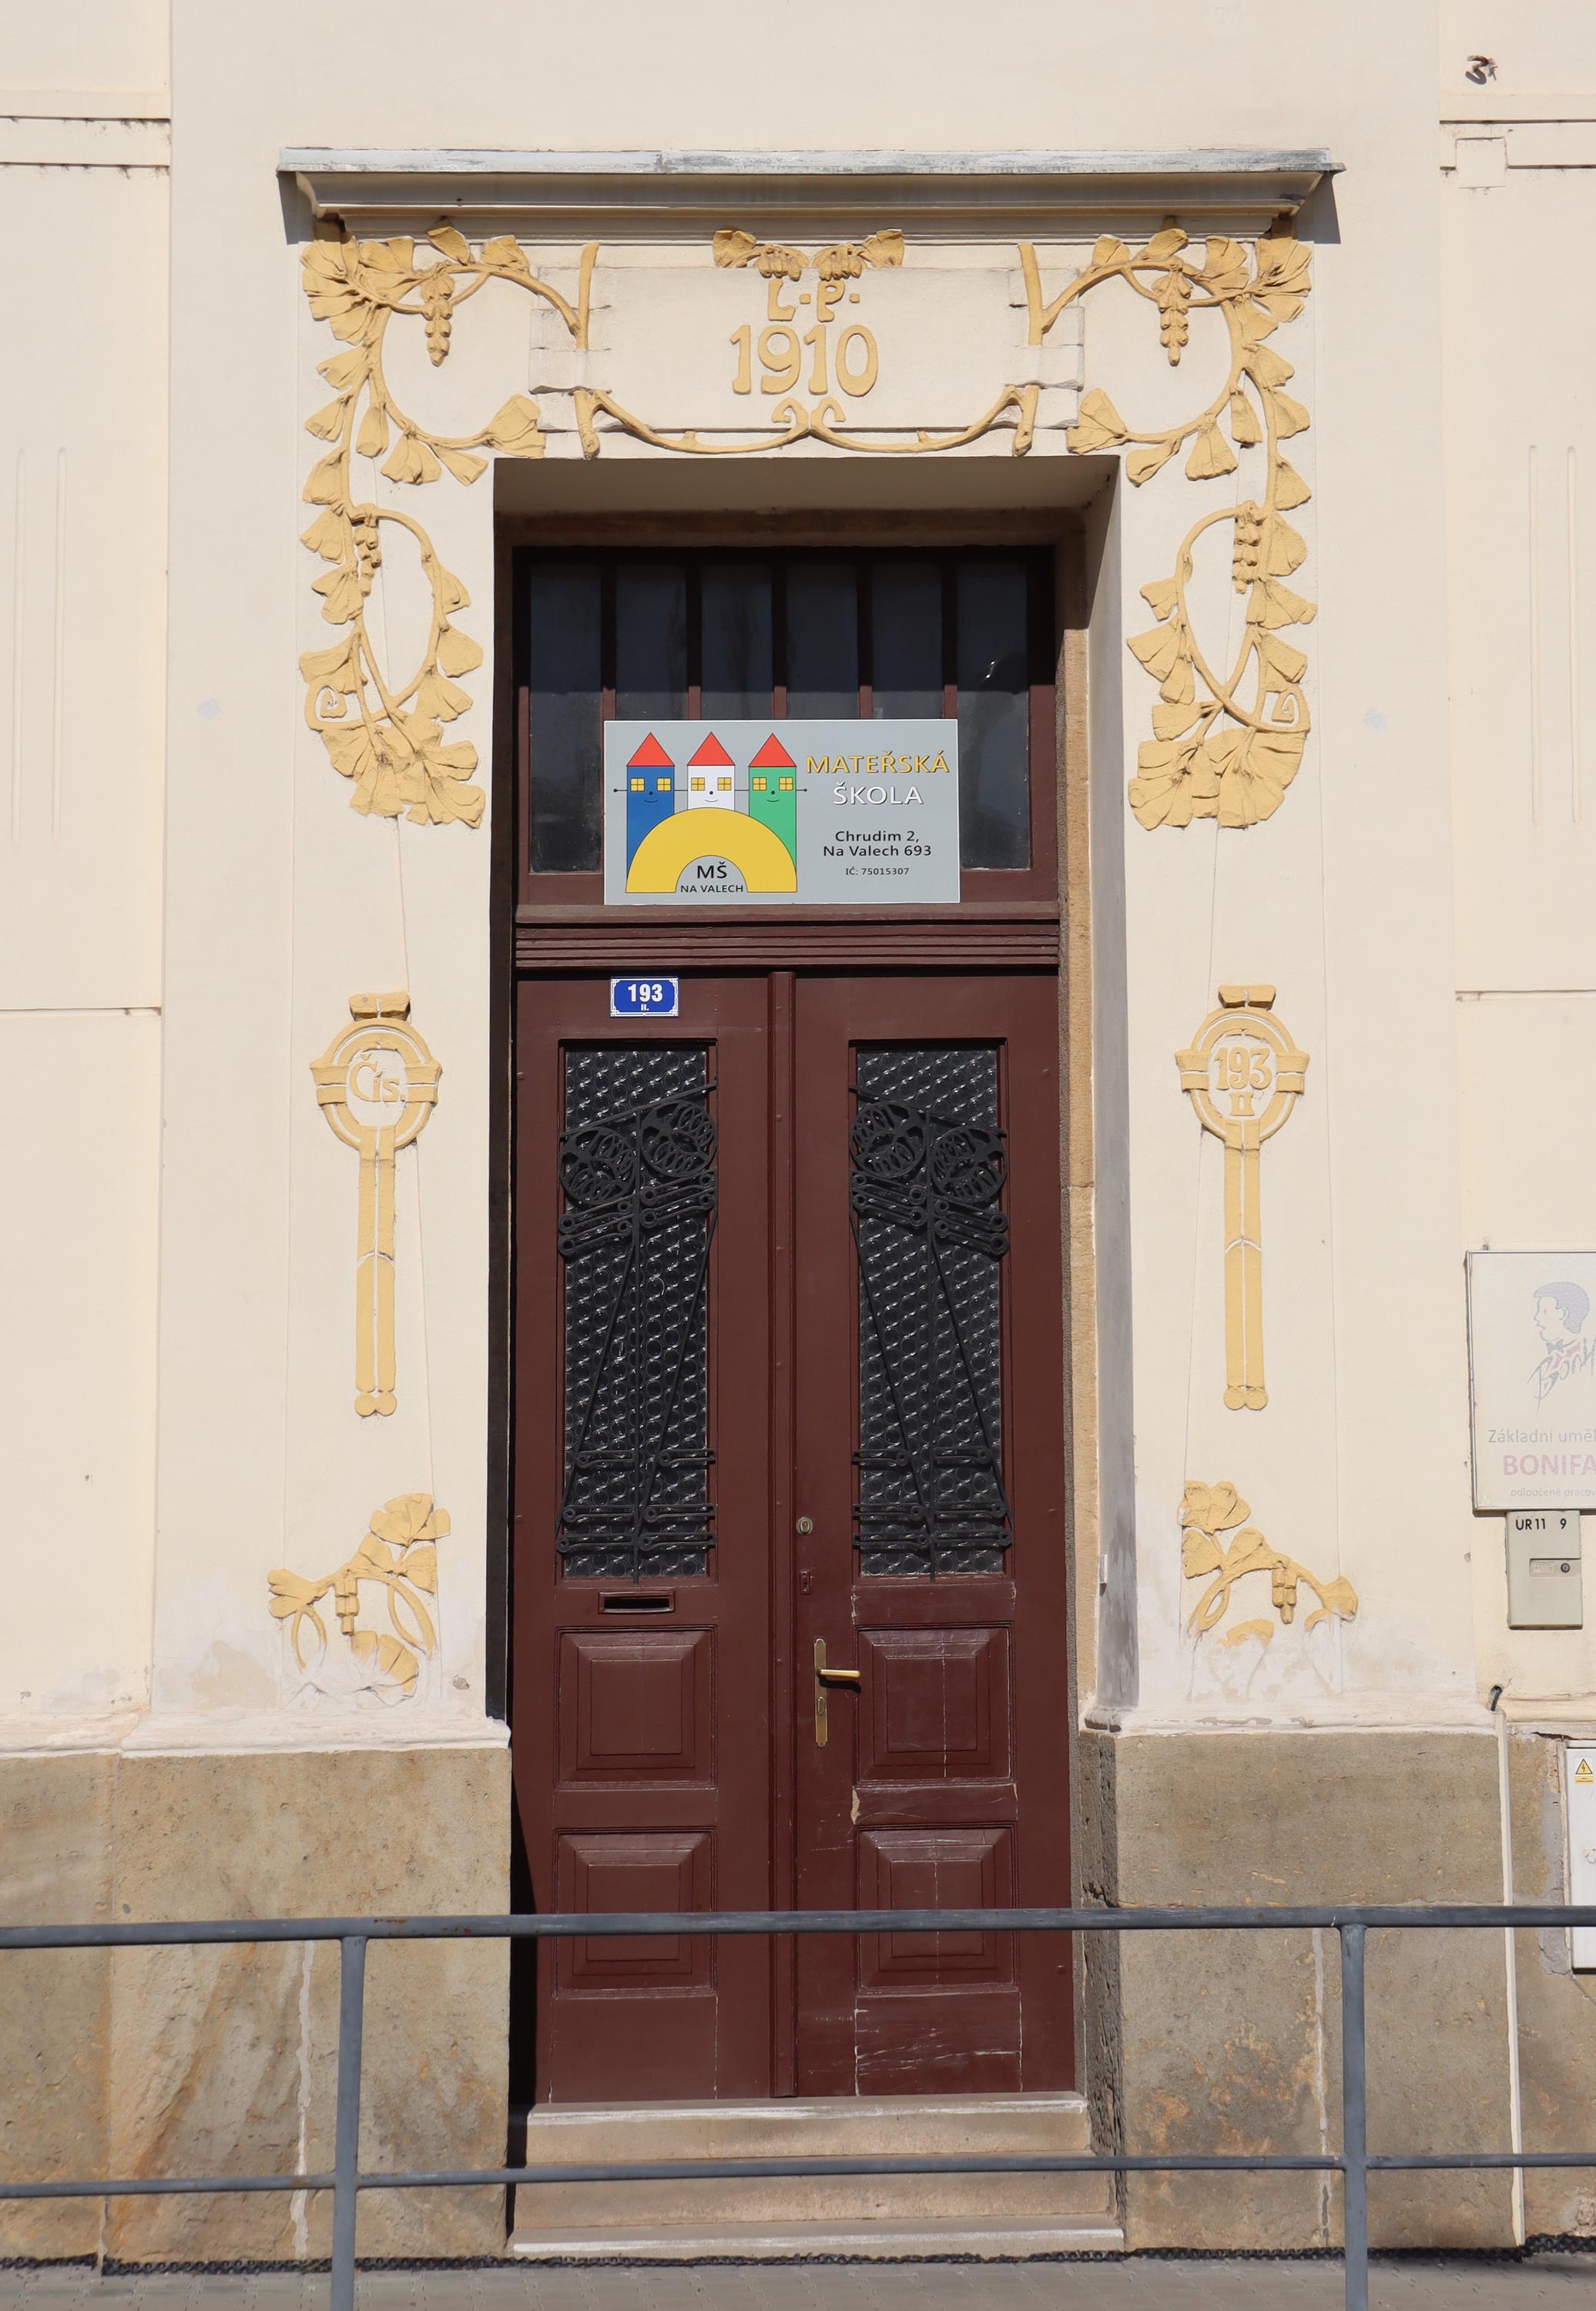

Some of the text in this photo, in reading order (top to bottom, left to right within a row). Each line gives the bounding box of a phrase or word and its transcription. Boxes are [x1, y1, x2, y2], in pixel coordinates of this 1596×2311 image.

[729, 324, 878, 397] 1910
[806, 750, 950, 773] MATEŘSKÁ
[833, 781, 924, 805] ŠKOLA
[835, 830, 919, 843] Chrudim 2,
[823, 845, 931, 857] Na Valech 693
[697, 861, 727, 879] MŠ
[846, 867, 859, 875] IČ:
[628, 984, 663, 1002] 193
[1214, 1047, 1272, 1091] 193
[1488, 1429, 1553, 1443] Základní
[1503, 1454, 1596, 1476] BONIFA
[1510, 1488, 1561, 1497] odloučené
[1560, 1518, 1567, 1530] 9
